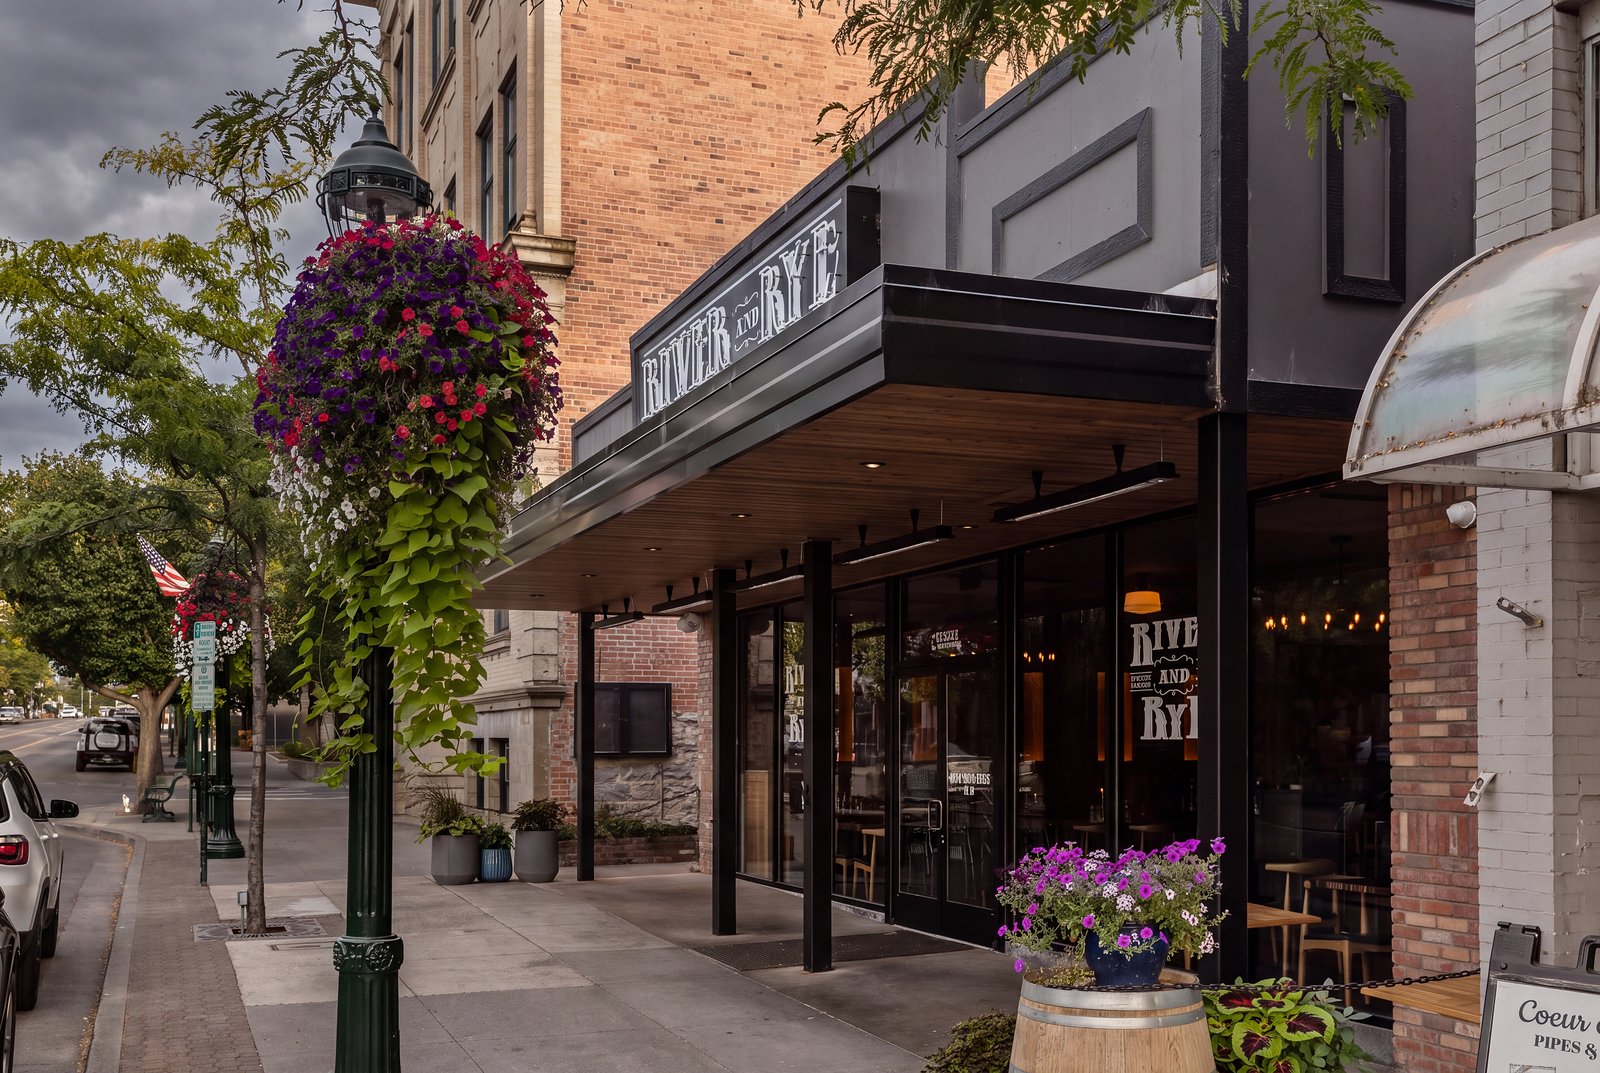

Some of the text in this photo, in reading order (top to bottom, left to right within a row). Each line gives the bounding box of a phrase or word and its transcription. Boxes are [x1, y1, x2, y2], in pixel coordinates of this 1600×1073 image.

[641, 219, 841, 422] RIVER AND RYE
[1158, 668, 1191, 685] AND
[1518, 999, 1592, 1032] Coeur
[1534, 1034, 1598, 1061] PIPES &
